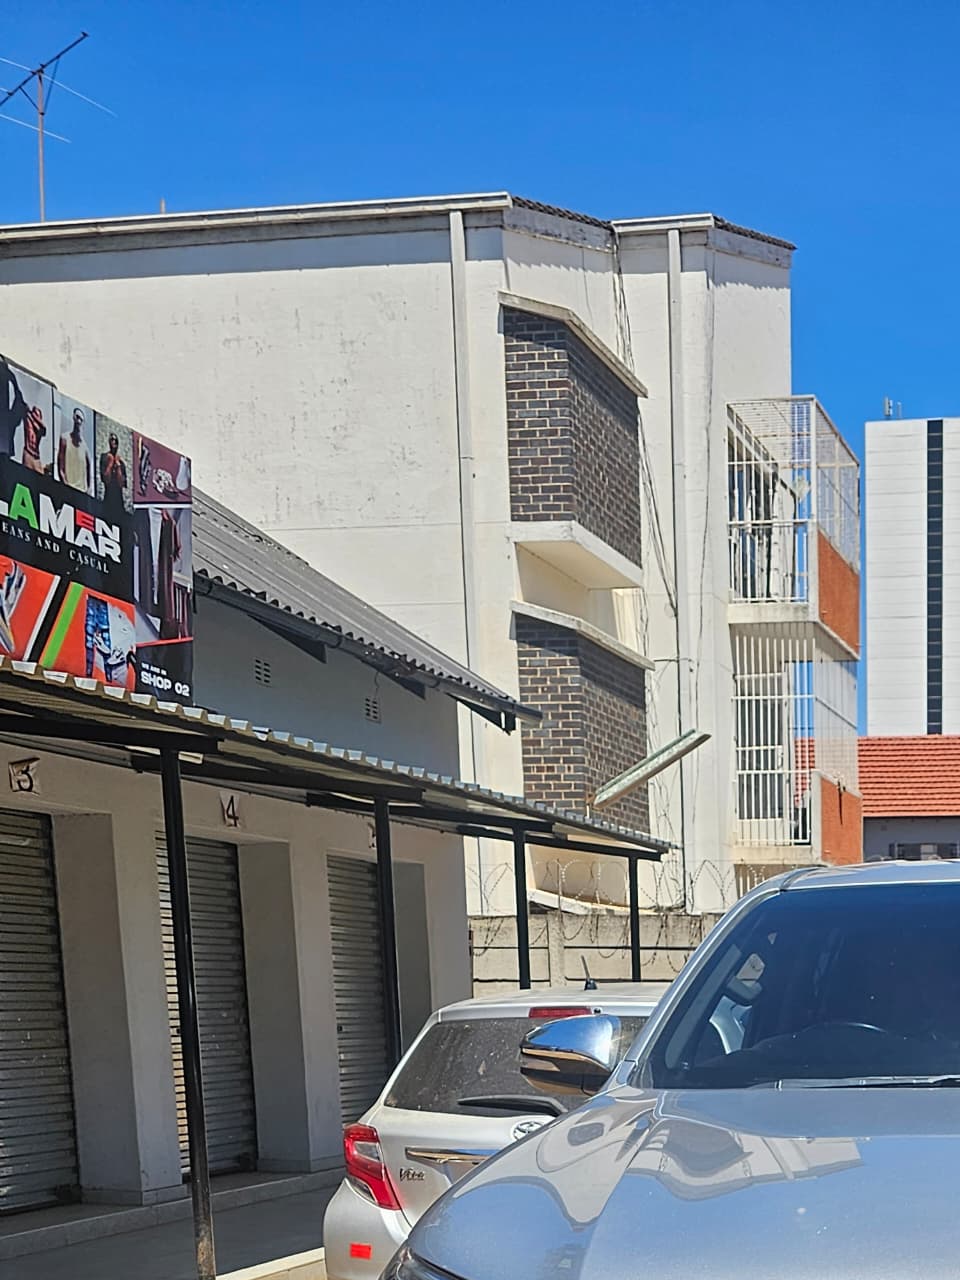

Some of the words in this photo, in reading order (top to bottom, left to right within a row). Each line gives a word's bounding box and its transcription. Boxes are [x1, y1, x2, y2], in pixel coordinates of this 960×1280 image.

[1, 521, 31, 543] EANS
[36, 536, 60, 553] AND
[69, 549, 109, 574] CASUAL
[141, 670, 172, 691] SHOP
[174, 681, 190, 697] 02
[226, 795, 240, 827] 4
